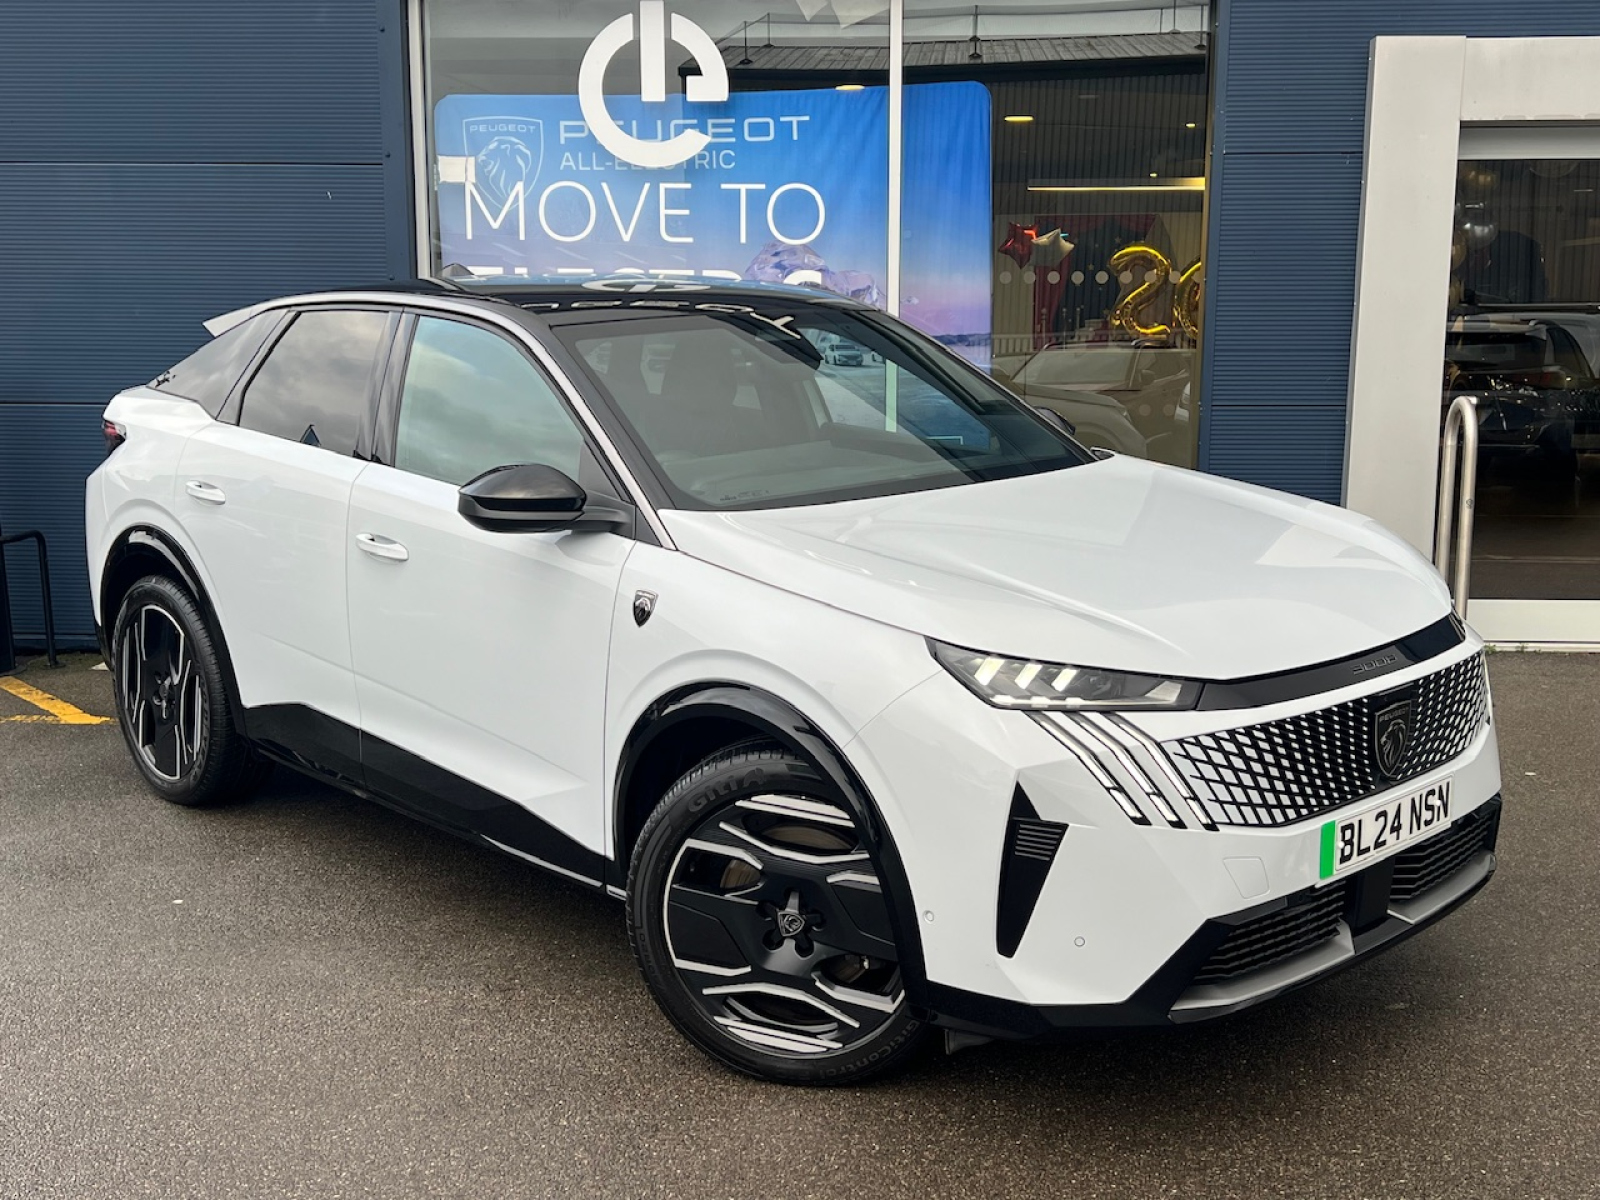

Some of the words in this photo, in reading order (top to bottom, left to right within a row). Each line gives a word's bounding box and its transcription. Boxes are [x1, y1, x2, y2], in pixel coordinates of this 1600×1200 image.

[469, 124, 536, 134] PEUGEOT
[559, 115, 810, 145] PUGEOT
[465, 181, 694, 243] MOVE
[720, 183, 826, 245] TO
[1339, 803, 1402, 864] BL24
[1409, 781, 1451, 835] NSN
